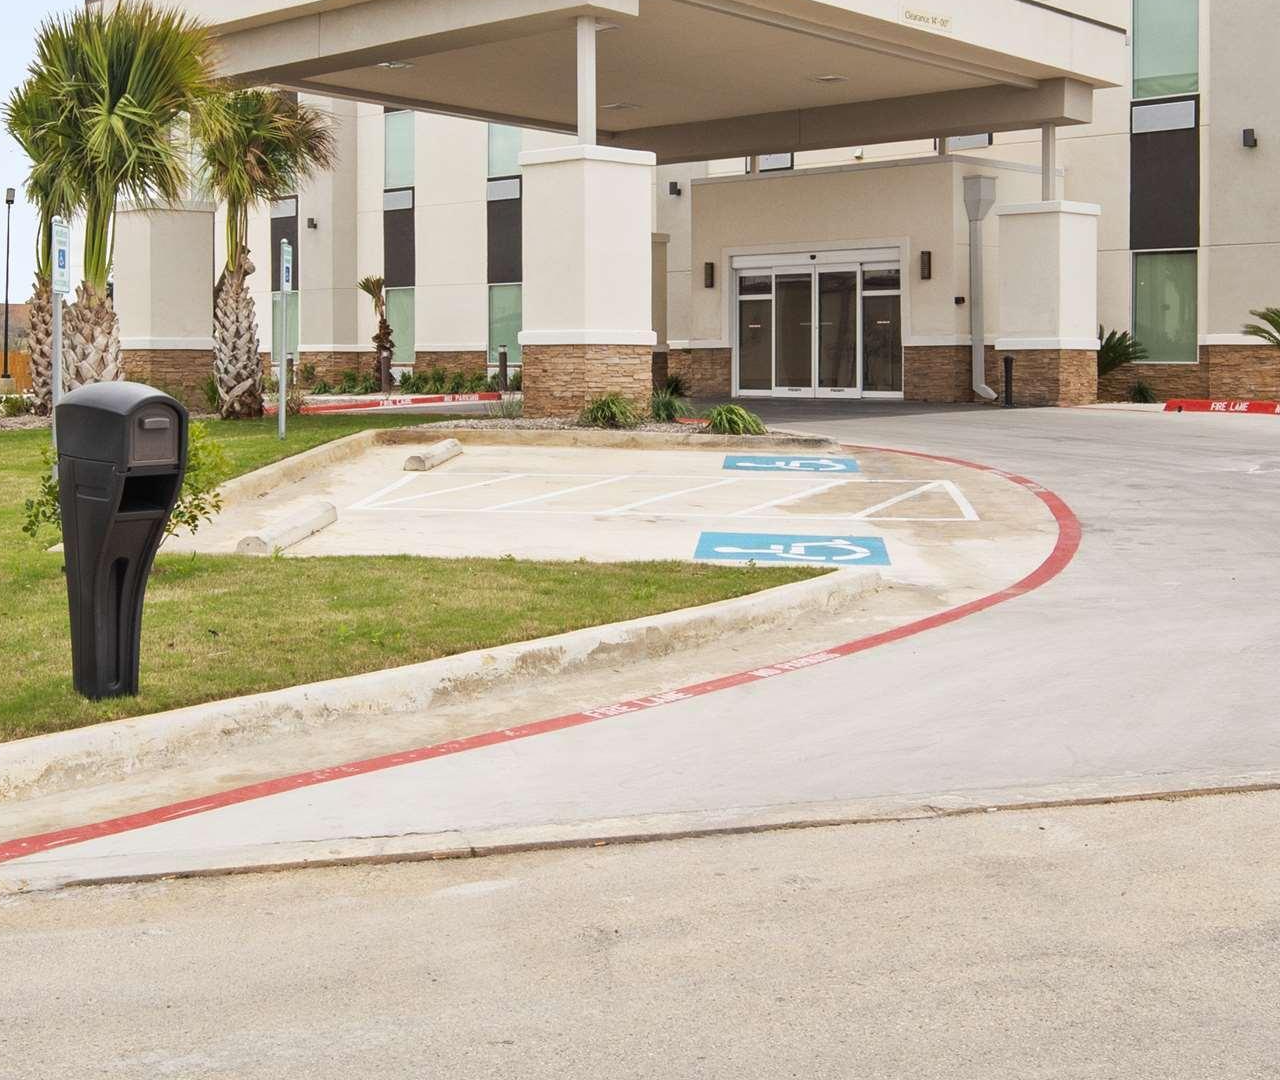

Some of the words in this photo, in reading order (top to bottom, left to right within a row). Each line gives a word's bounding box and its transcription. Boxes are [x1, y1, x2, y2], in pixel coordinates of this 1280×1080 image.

[1210, 402, 1228, 411] FIRE
[1229, 402, 1250, 412] LANE
[582, 703, 640, 719] FIRE
